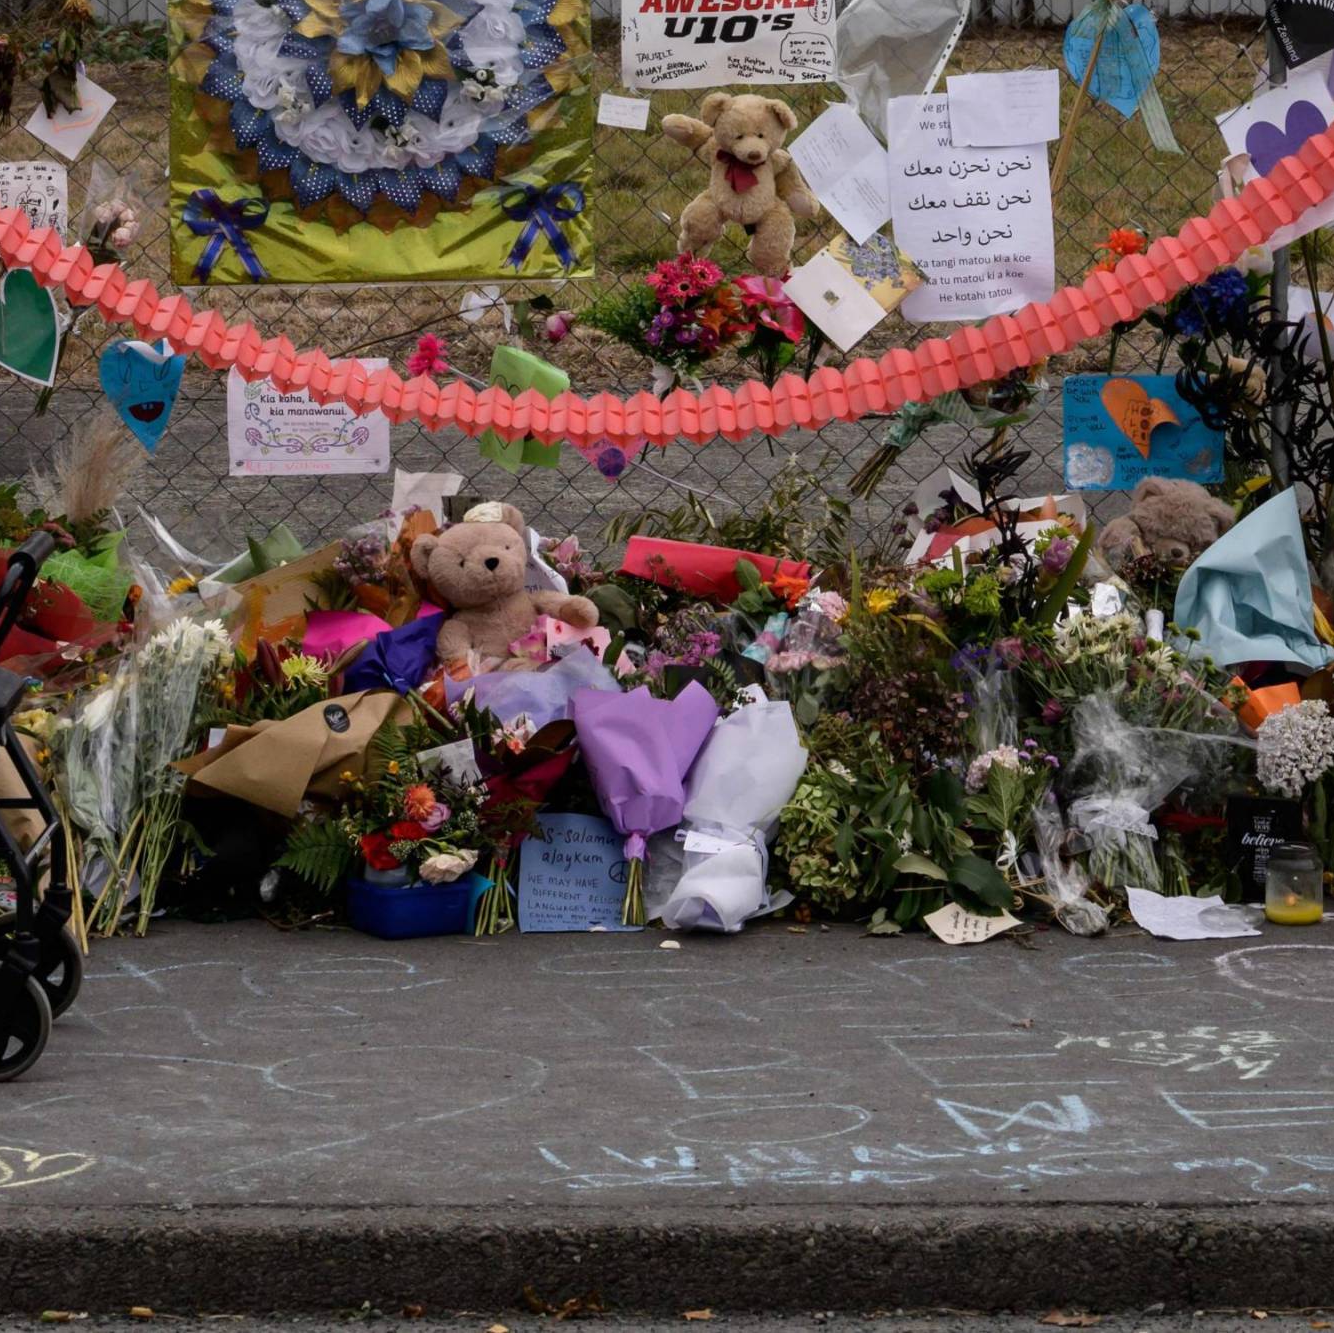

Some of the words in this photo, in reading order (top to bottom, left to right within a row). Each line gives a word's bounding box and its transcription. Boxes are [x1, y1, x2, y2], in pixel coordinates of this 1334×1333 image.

[1277, 24, 1300, 62] Zealand
[919, 121, 936, 131] We
[903, 159, 944, 178] معك
[949, 157, 991, 179] نحزن
[996, 153, 1033, 177] نحن
[908, 192, 948, 211] معك
[952, 192, 991, 209] نقف
[996, 188, 1033, 211] نحن
[931, 226, 974, 247] واحد
[977, 222, 1014, 245] نحن
[931, 257, 957, 272] tangi
[958, 256, 992, 267] matou
[993, 254, 1003, 265] ki
[1004, 256, 1011, 264] a
[1012, 253, 1032, 264] koe
[940, 276, 951, 286] tu
[953, 274, 985, 285] matou
[987, 271, 996, 282] ki
[997, 273, 1004, 281] a
[1005, 269, 1025, 280] koe
[939, 292, 954, 303] He
[955, 290, 986, 302] kotahi
[987, 287, 1013, 300] tatou
[260, 395, 276, 404] Kia
[279, 394, 305, 405] kaha,
[270, 408, 284, 416] kia
[287, 408, 347, 417] manawanui.
[527, 874, 544, 883] WE
[548, 877, 570, 885] MAY
[576, 878, 599, 889] HAVE
[532, 889, 580, 901] DIFFERENT
